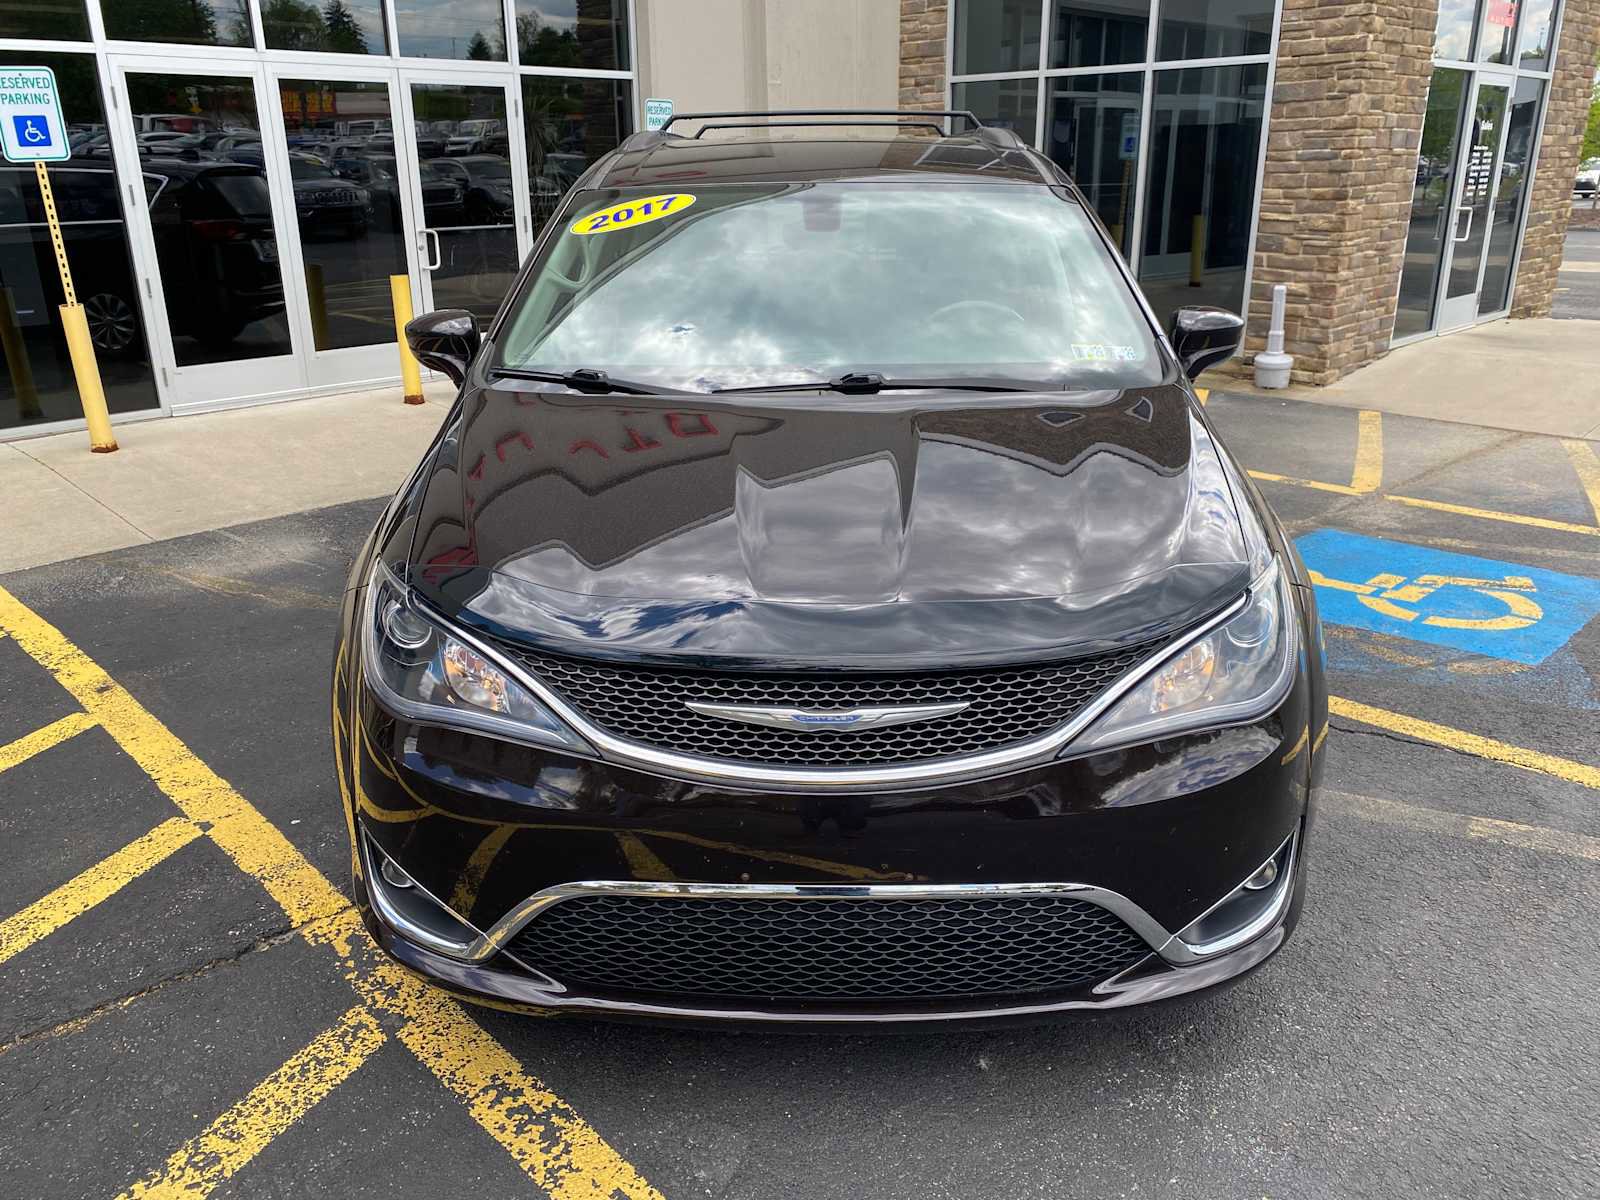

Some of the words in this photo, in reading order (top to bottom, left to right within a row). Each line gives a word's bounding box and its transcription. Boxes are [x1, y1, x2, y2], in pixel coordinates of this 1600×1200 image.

[0, 76, 50, 88] ESERVED
[0, 93, 50, 105] PARKING
[648, 116, 667, 127] PARKI
[588, 196, 677, 231] 2017
